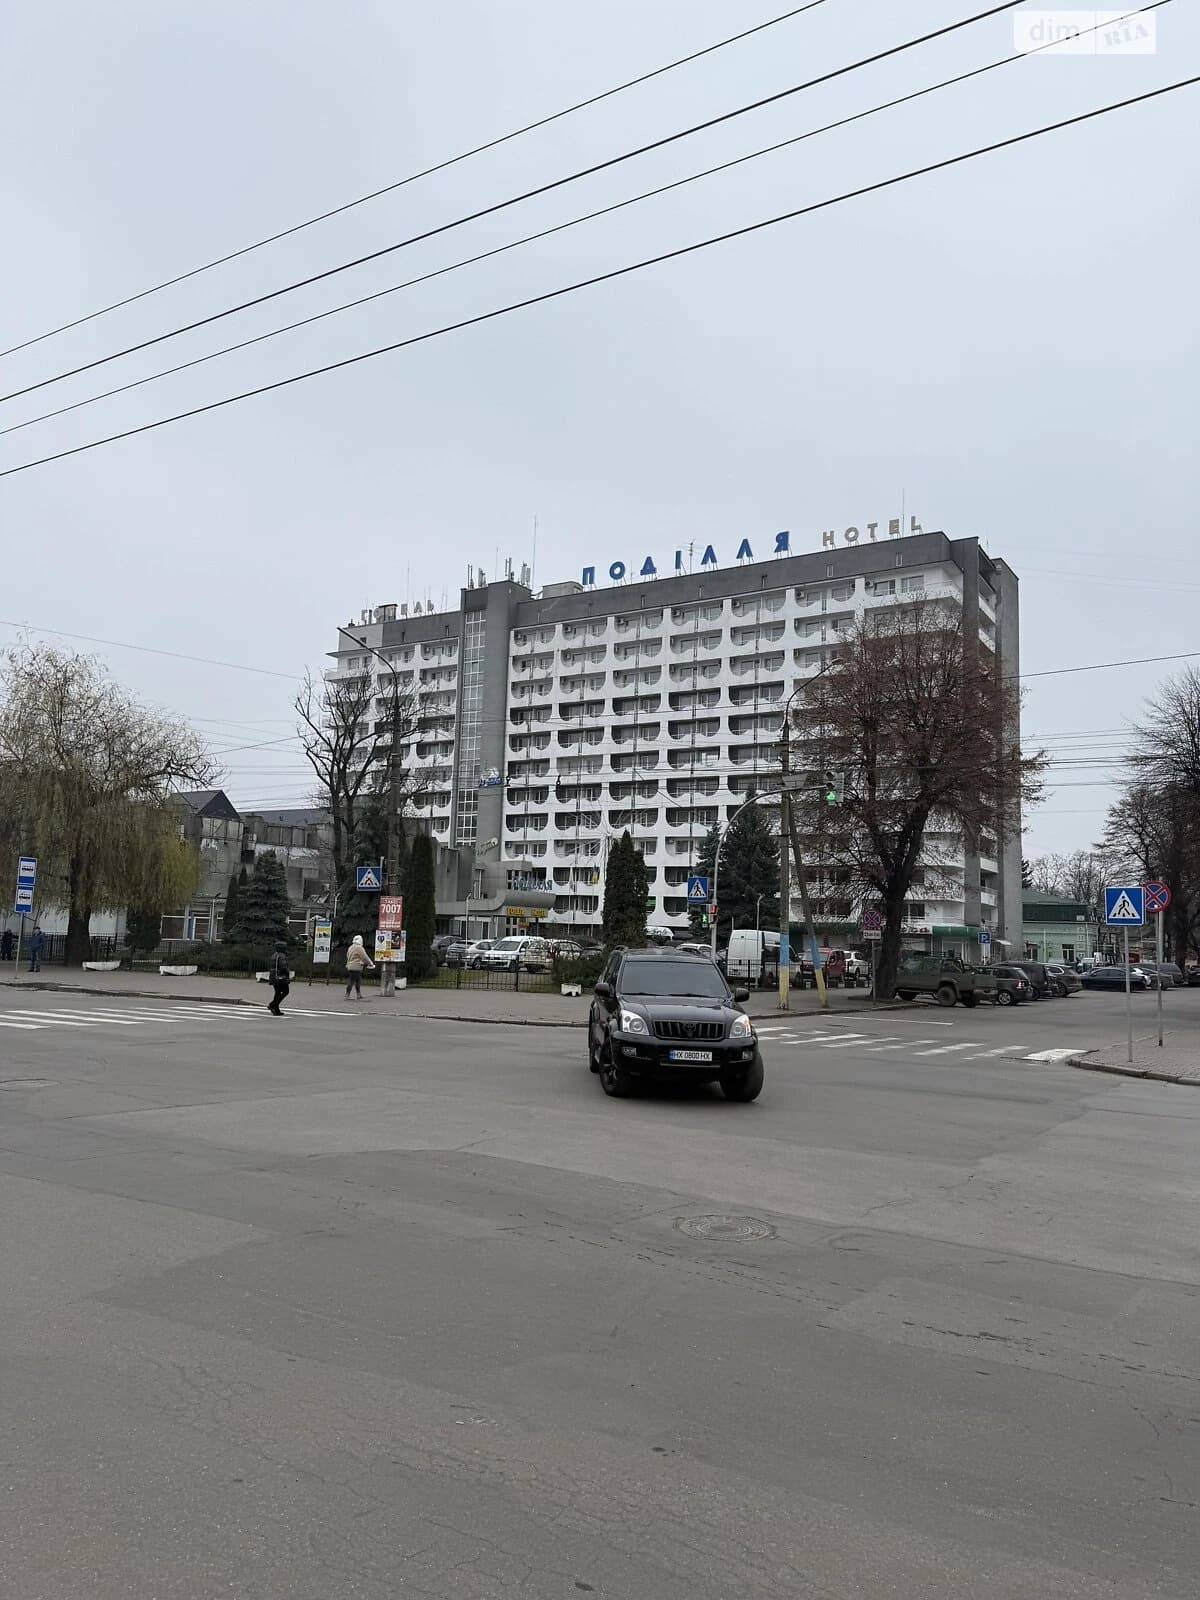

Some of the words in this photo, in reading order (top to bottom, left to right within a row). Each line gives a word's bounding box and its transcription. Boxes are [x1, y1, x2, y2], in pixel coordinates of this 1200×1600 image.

[822, 515, 922, 547] HOTEL
[582, 530, 790, 586] ПОДІЛЛЯ
[380, 903, 401, 913] 7007
[980, 934, 989, 943] P
